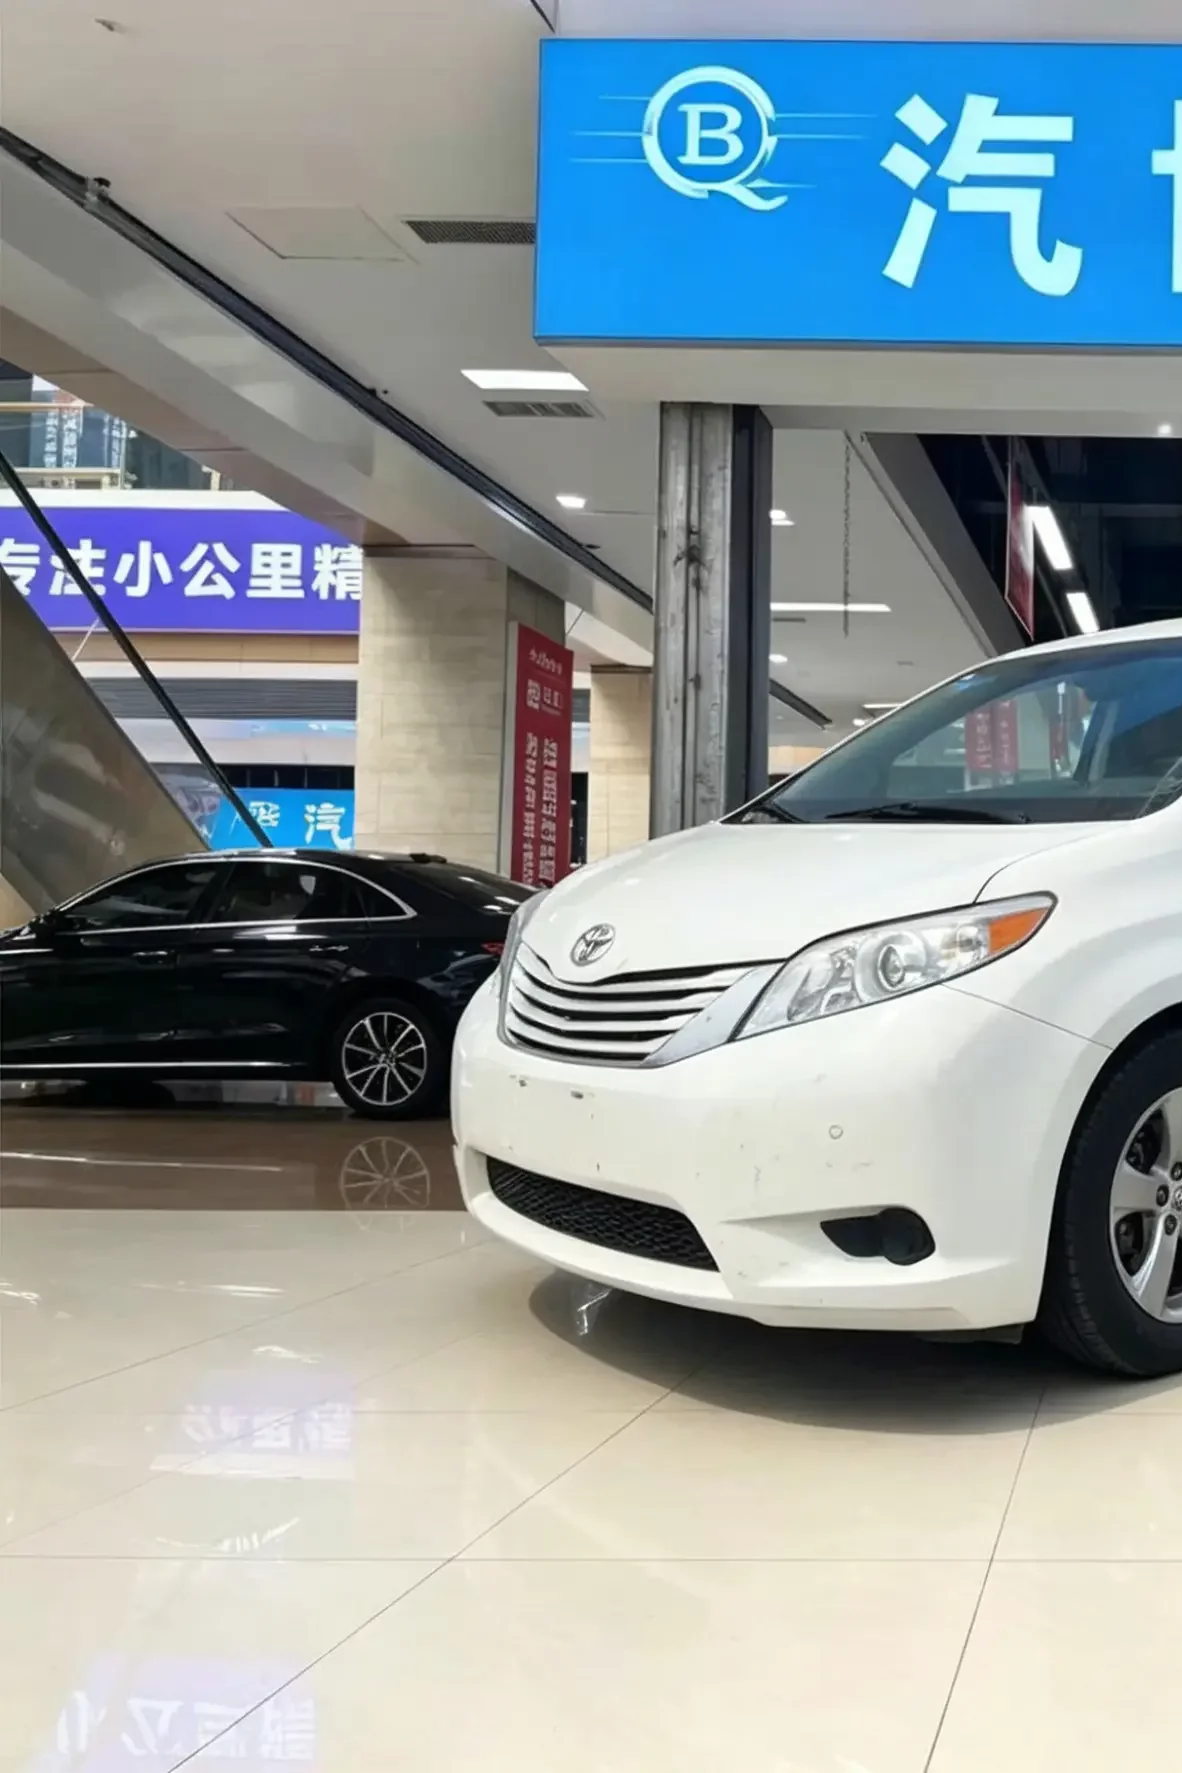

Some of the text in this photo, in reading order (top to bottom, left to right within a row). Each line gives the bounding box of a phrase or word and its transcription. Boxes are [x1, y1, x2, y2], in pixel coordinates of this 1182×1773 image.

[0, 538, 363, 600] 专注小公里精
